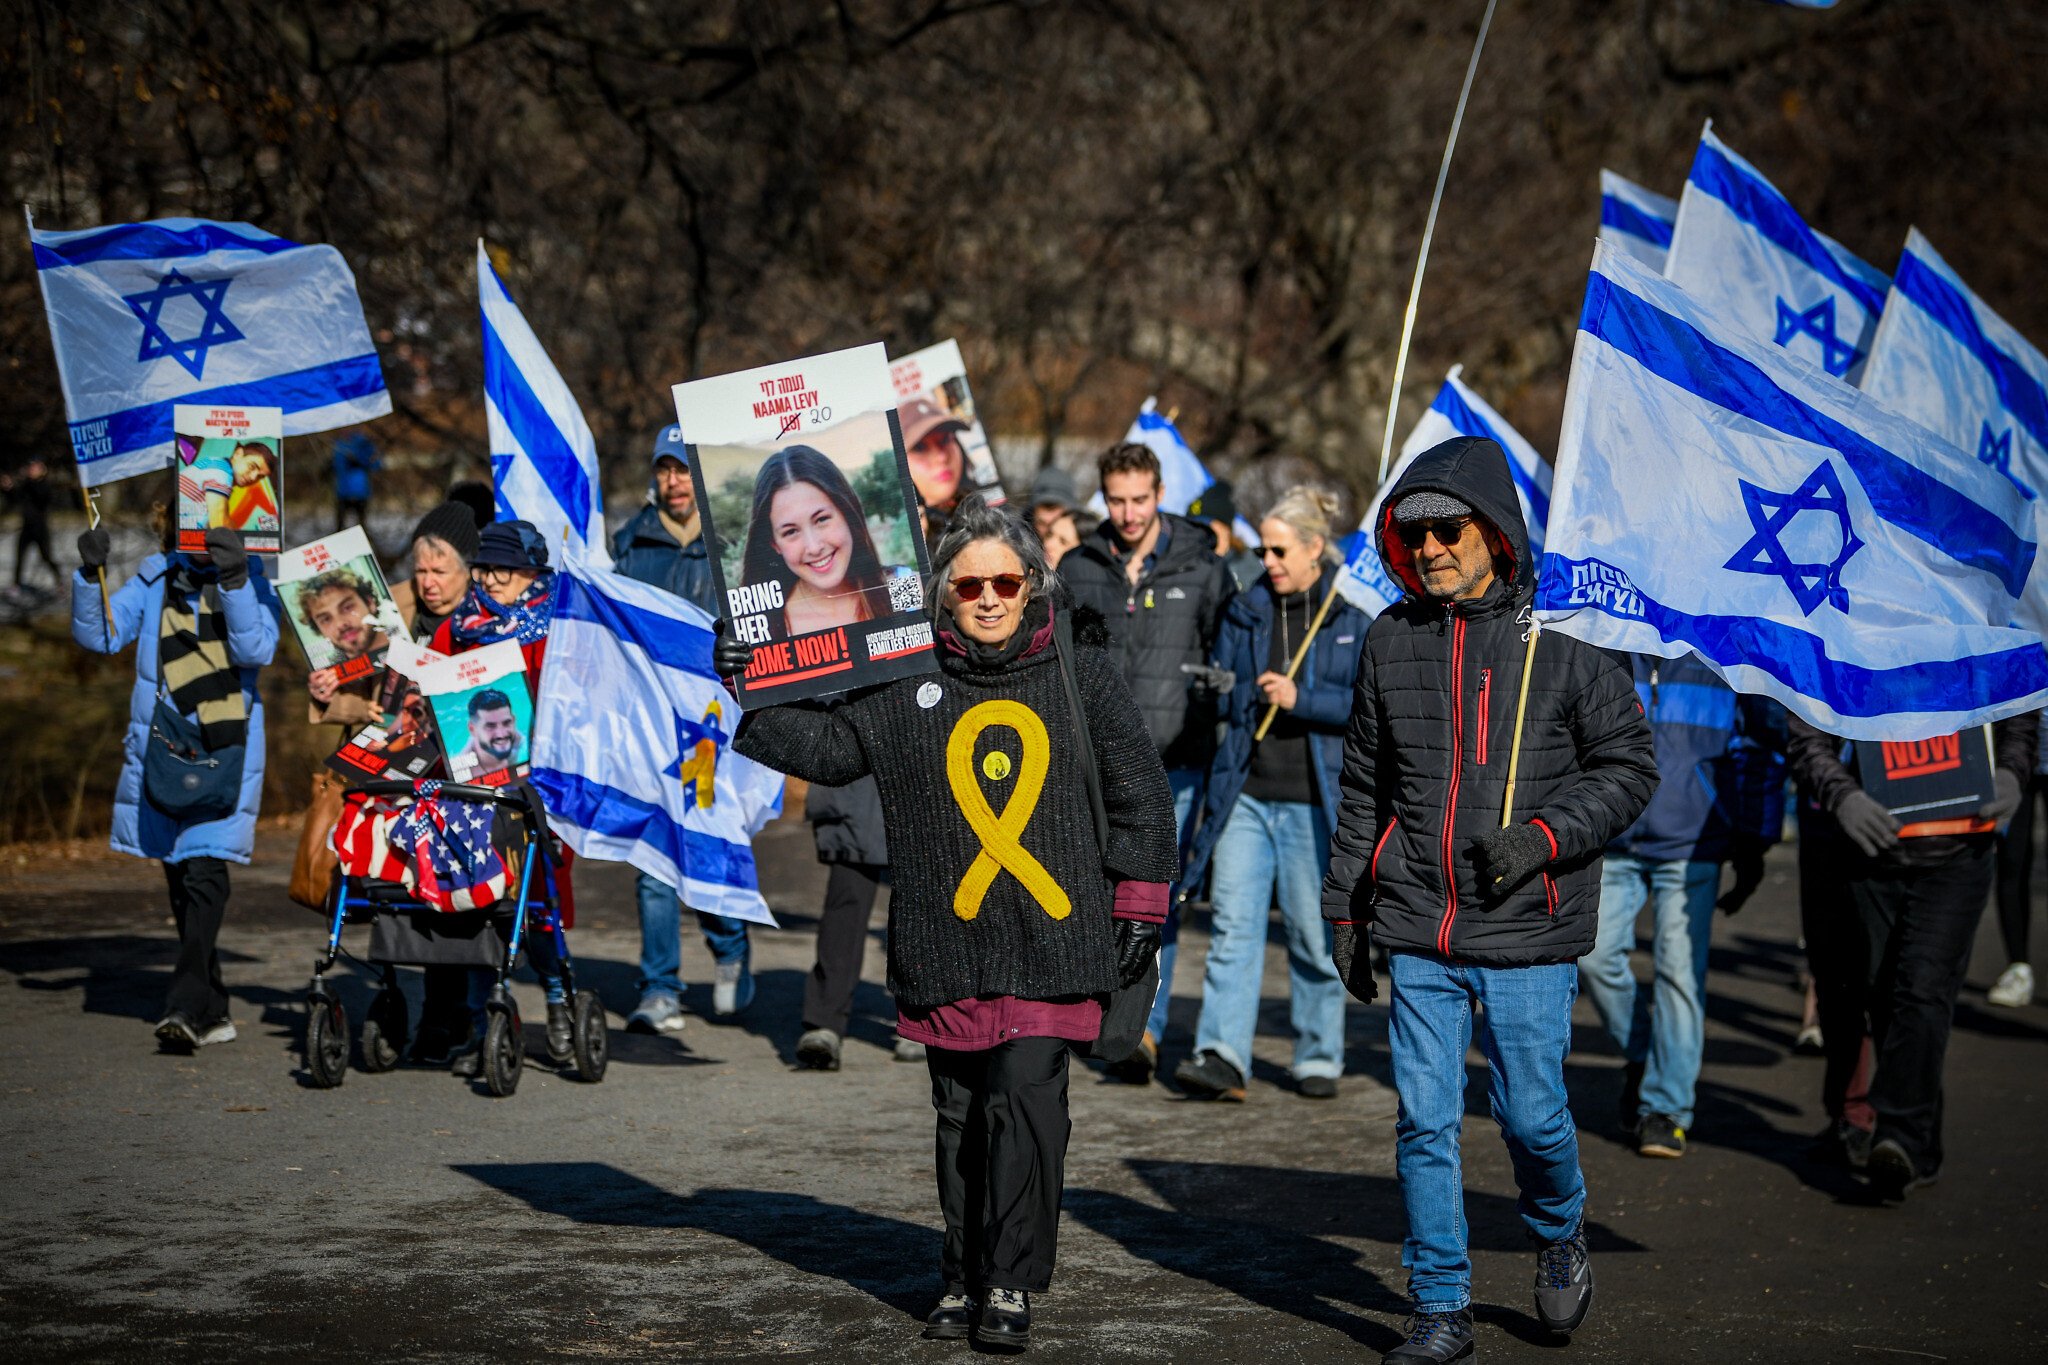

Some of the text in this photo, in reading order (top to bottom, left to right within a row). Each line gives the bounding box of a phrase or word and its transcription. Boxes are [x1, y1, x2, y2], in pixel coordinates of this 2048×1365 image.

[759, 374, 805, 397] נעמה לוי
[752, 390, 819, 419] NAAMA LEVY
[810, 406, 832, 424] 20
[727, 580, 785, 618] BRING
[733, 614, 773, 645] HER
[865, 621, 932, 644] HOSTAGES AND MISSING
[794, 626, 850, 668] NOW!
[867, 637, 904, 656] FAMILIES
